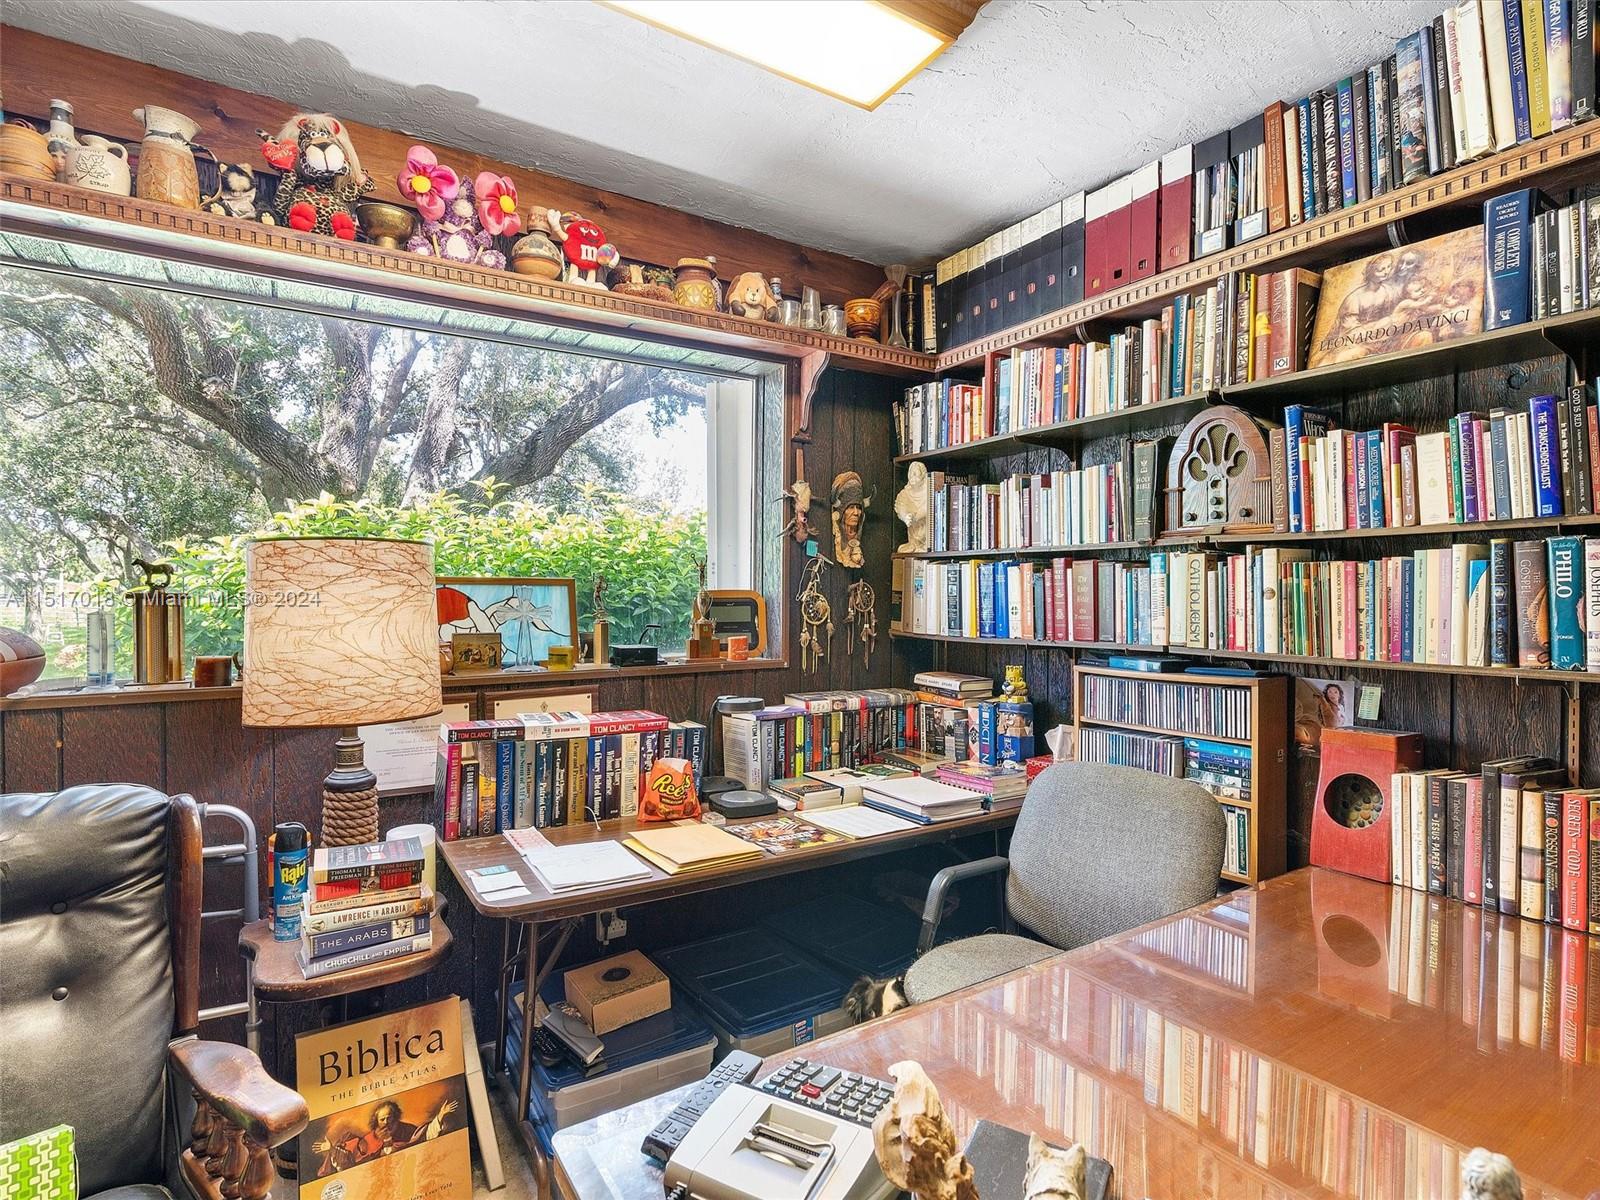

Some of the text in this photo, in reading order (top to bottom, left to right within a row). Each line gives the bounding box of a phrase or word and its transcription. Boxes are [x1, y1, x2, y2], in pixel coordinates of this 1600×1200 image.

[1510, 27, 1523, 76] PAST TIMES
[1322, 98, 1338, 191] COSMOS CARL SAGAN
[1340, 92, 1352, 172] HOW WORLD?
[1494, 232, 1505, 272] WORDFINDER
[1506, 228, 1520, 269] COMPLETE
[1548, 251, 1557, 278] DOUBT
[1319, 308, 1470, 352] LEONARDO DA VINCI
[1572, 388, 1581, 404] GOD
[1573, 414, 1582, 428] RED
[1461, 432, 1473, 466] Celebrate
[1538, 412, 1551, 489] THE TRANSCENDENTALISTS
[1273, 435, 1284, 515] DRINKING SAINTS
[1496, 460, 1507, 498] Muhammad
[1520, 560, 1531, 595] GOSPEL
[1556, 550, 1572, 598] PHILO
[1589, 566, 1600, 617] JOSEPHUS
[1190, 558, 1200, 644] CATHOLICISM
[594, 726, 608, 734] TOM
[609, 724, 635, 733] CLANCY
[647, 734, 655, 750] Tom
[592, 753, 602, 772] Clancy
[606, 750, 614, 772] Without
[594, 774, 602, 790] Debt
[539, 782, 547, 828] Patriot Games
[594, 796, 602, 816] Honor
[1568, 800, 1581, 837] SECRETS
[1432, 818, 1440, 840] JESUS
[1432, 842, 1440, 870] PAPERS
[1546, 826, 1558, 868] ROSSLYN
[1567, 849, 1581, 878] CODE
[280, 862, 305, 883] Raid
[333, 910, 371, 924] LAWRENCE
[381, 905, 406, 916] ARABIA
[321, 928, 388, 949] THE ARABS
[324, 953, 370, 969] CHURCHILL
[384, 944, 412, 956] EMPIRE
[319, 1029, 444, 1086] Biblica
[331, 1065, 438, 1102] THE BIBLE ATLAS
